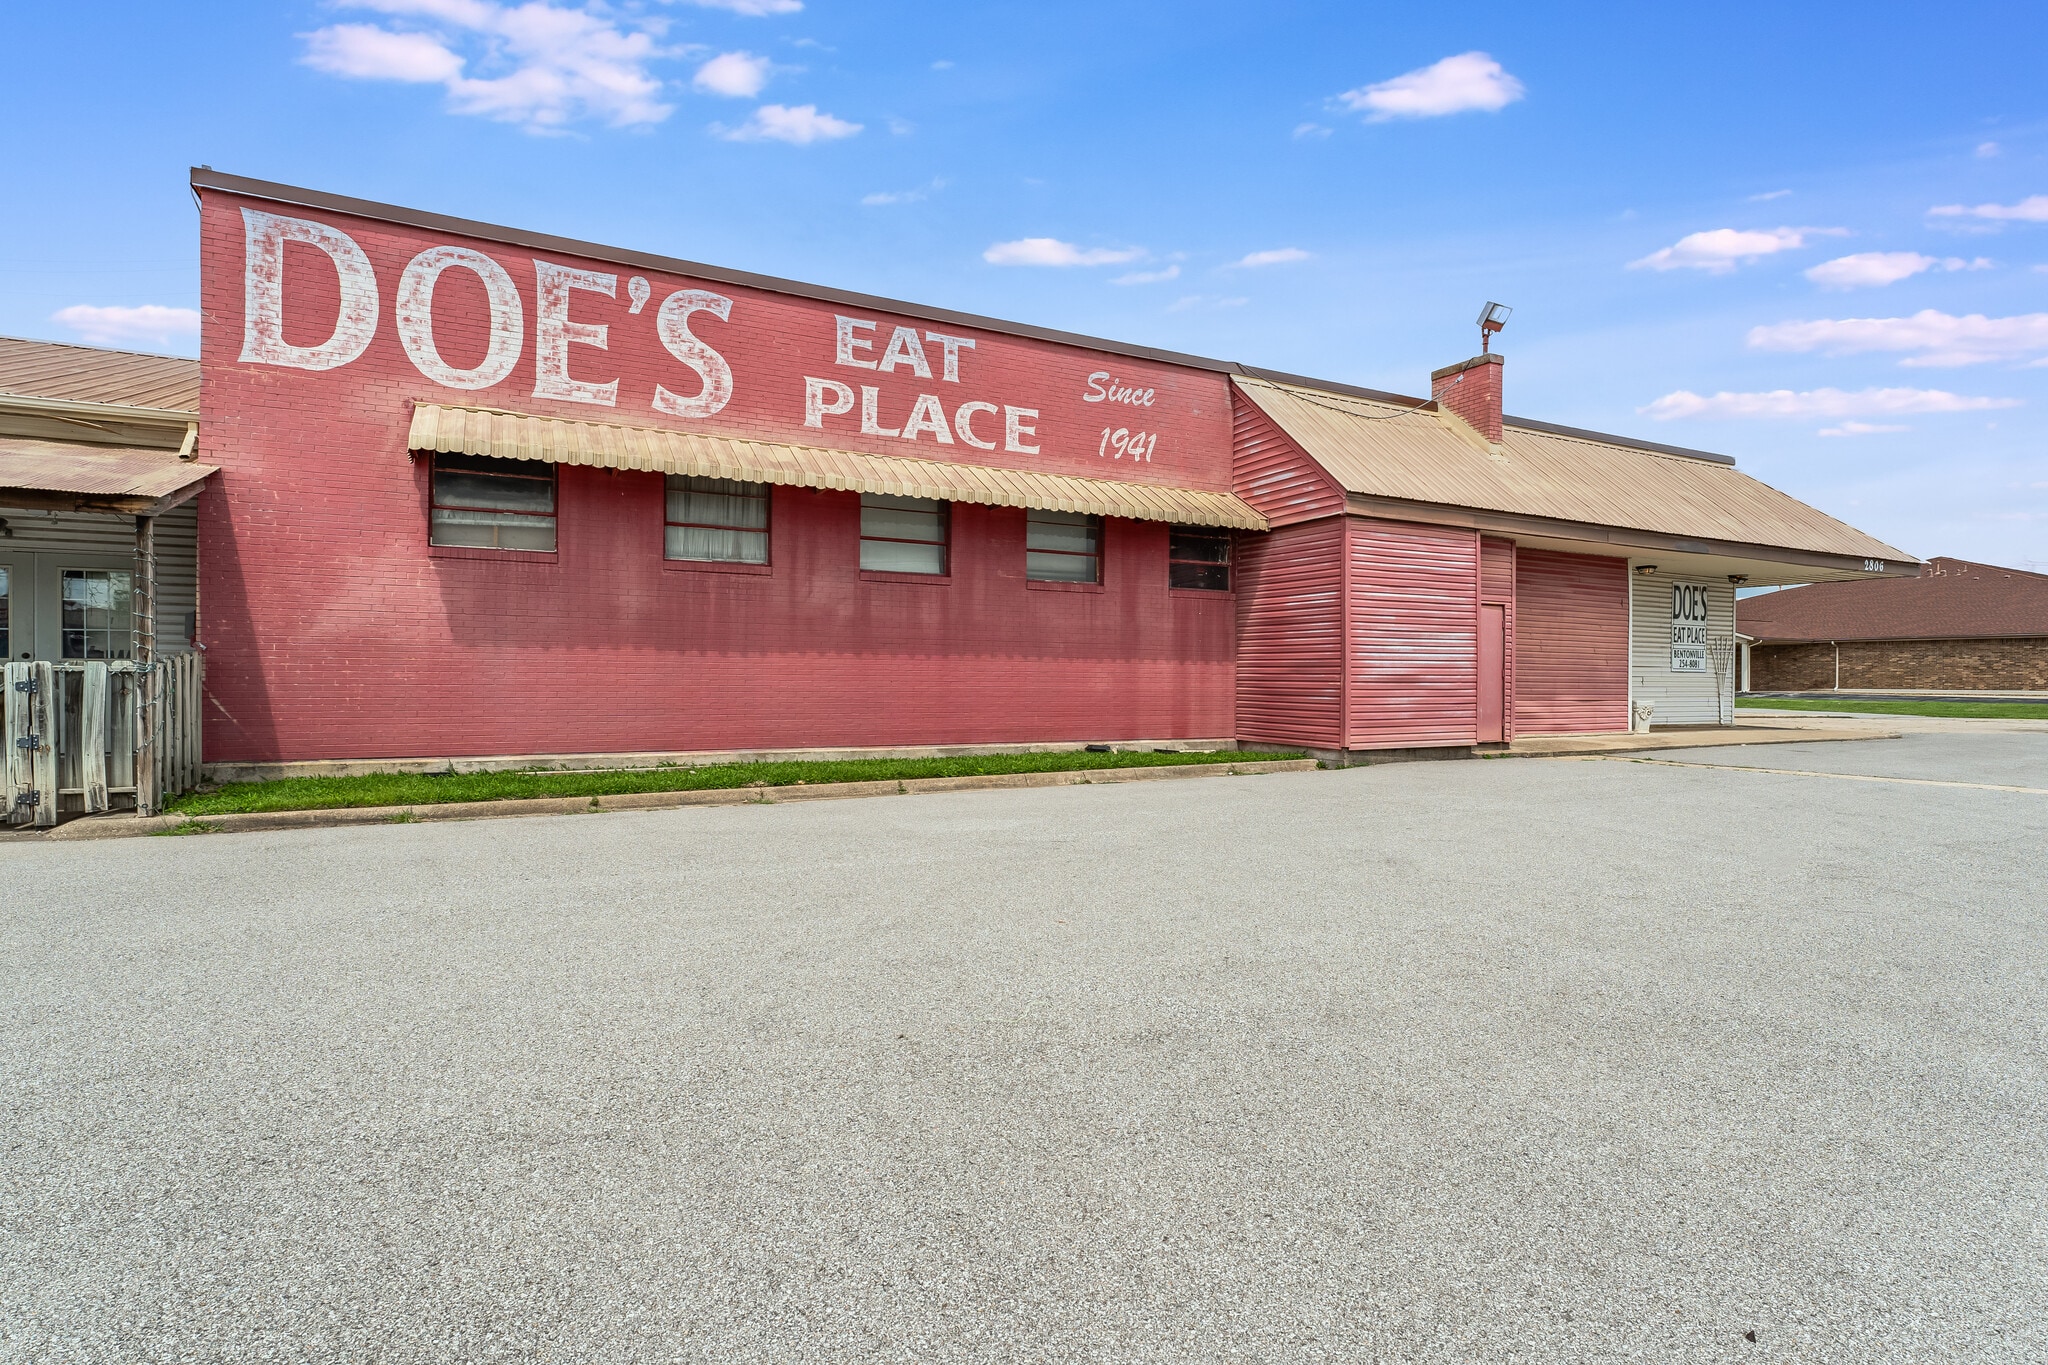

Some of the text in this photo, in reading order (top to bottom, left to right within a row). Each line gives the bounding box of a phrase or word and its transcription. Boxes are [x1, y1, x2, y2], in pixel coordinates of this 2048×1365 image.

[237, 206, 735, 419] DOE'S
[834, 314, 976, 383] EAT
[1082, 371, 1156, 407] Since
[803, 375, 1041, 455] PLACE
[1099, 426, 1158, 463] 1941
[1864, 559, 1884, 572] 2806
[1673, 627, 1705, 644] EAT PLACE
[1673, 649, 1705, 659] BENTONVILLE
